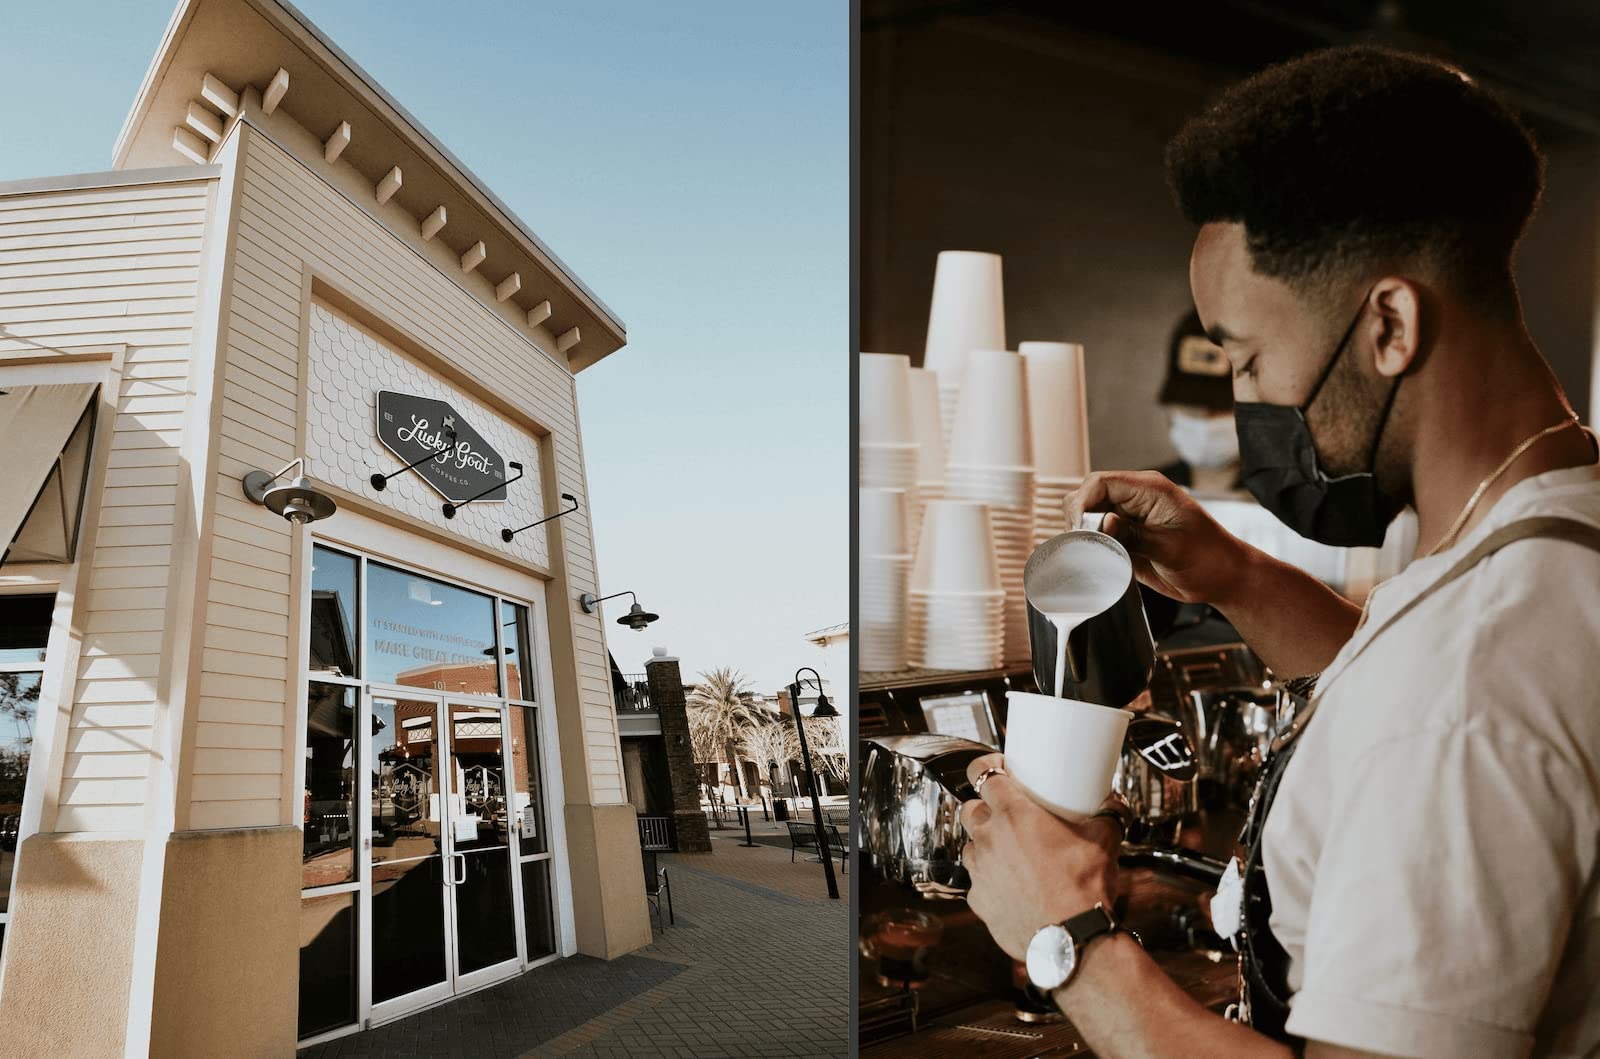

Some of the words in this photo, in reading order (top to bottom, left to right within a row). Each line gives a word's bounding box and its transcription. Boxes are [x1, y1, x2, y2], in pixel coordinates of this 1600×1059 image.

[398, 414, 454, 464] Lucky
[455, 441, 493, 475] Goat
[431, 464, 458, 483] COFFEE
[375, 640, 410, 658] MAKE
[413, 646, 448, 664] GREAT
[389, 779, 409, 796] Lucky
